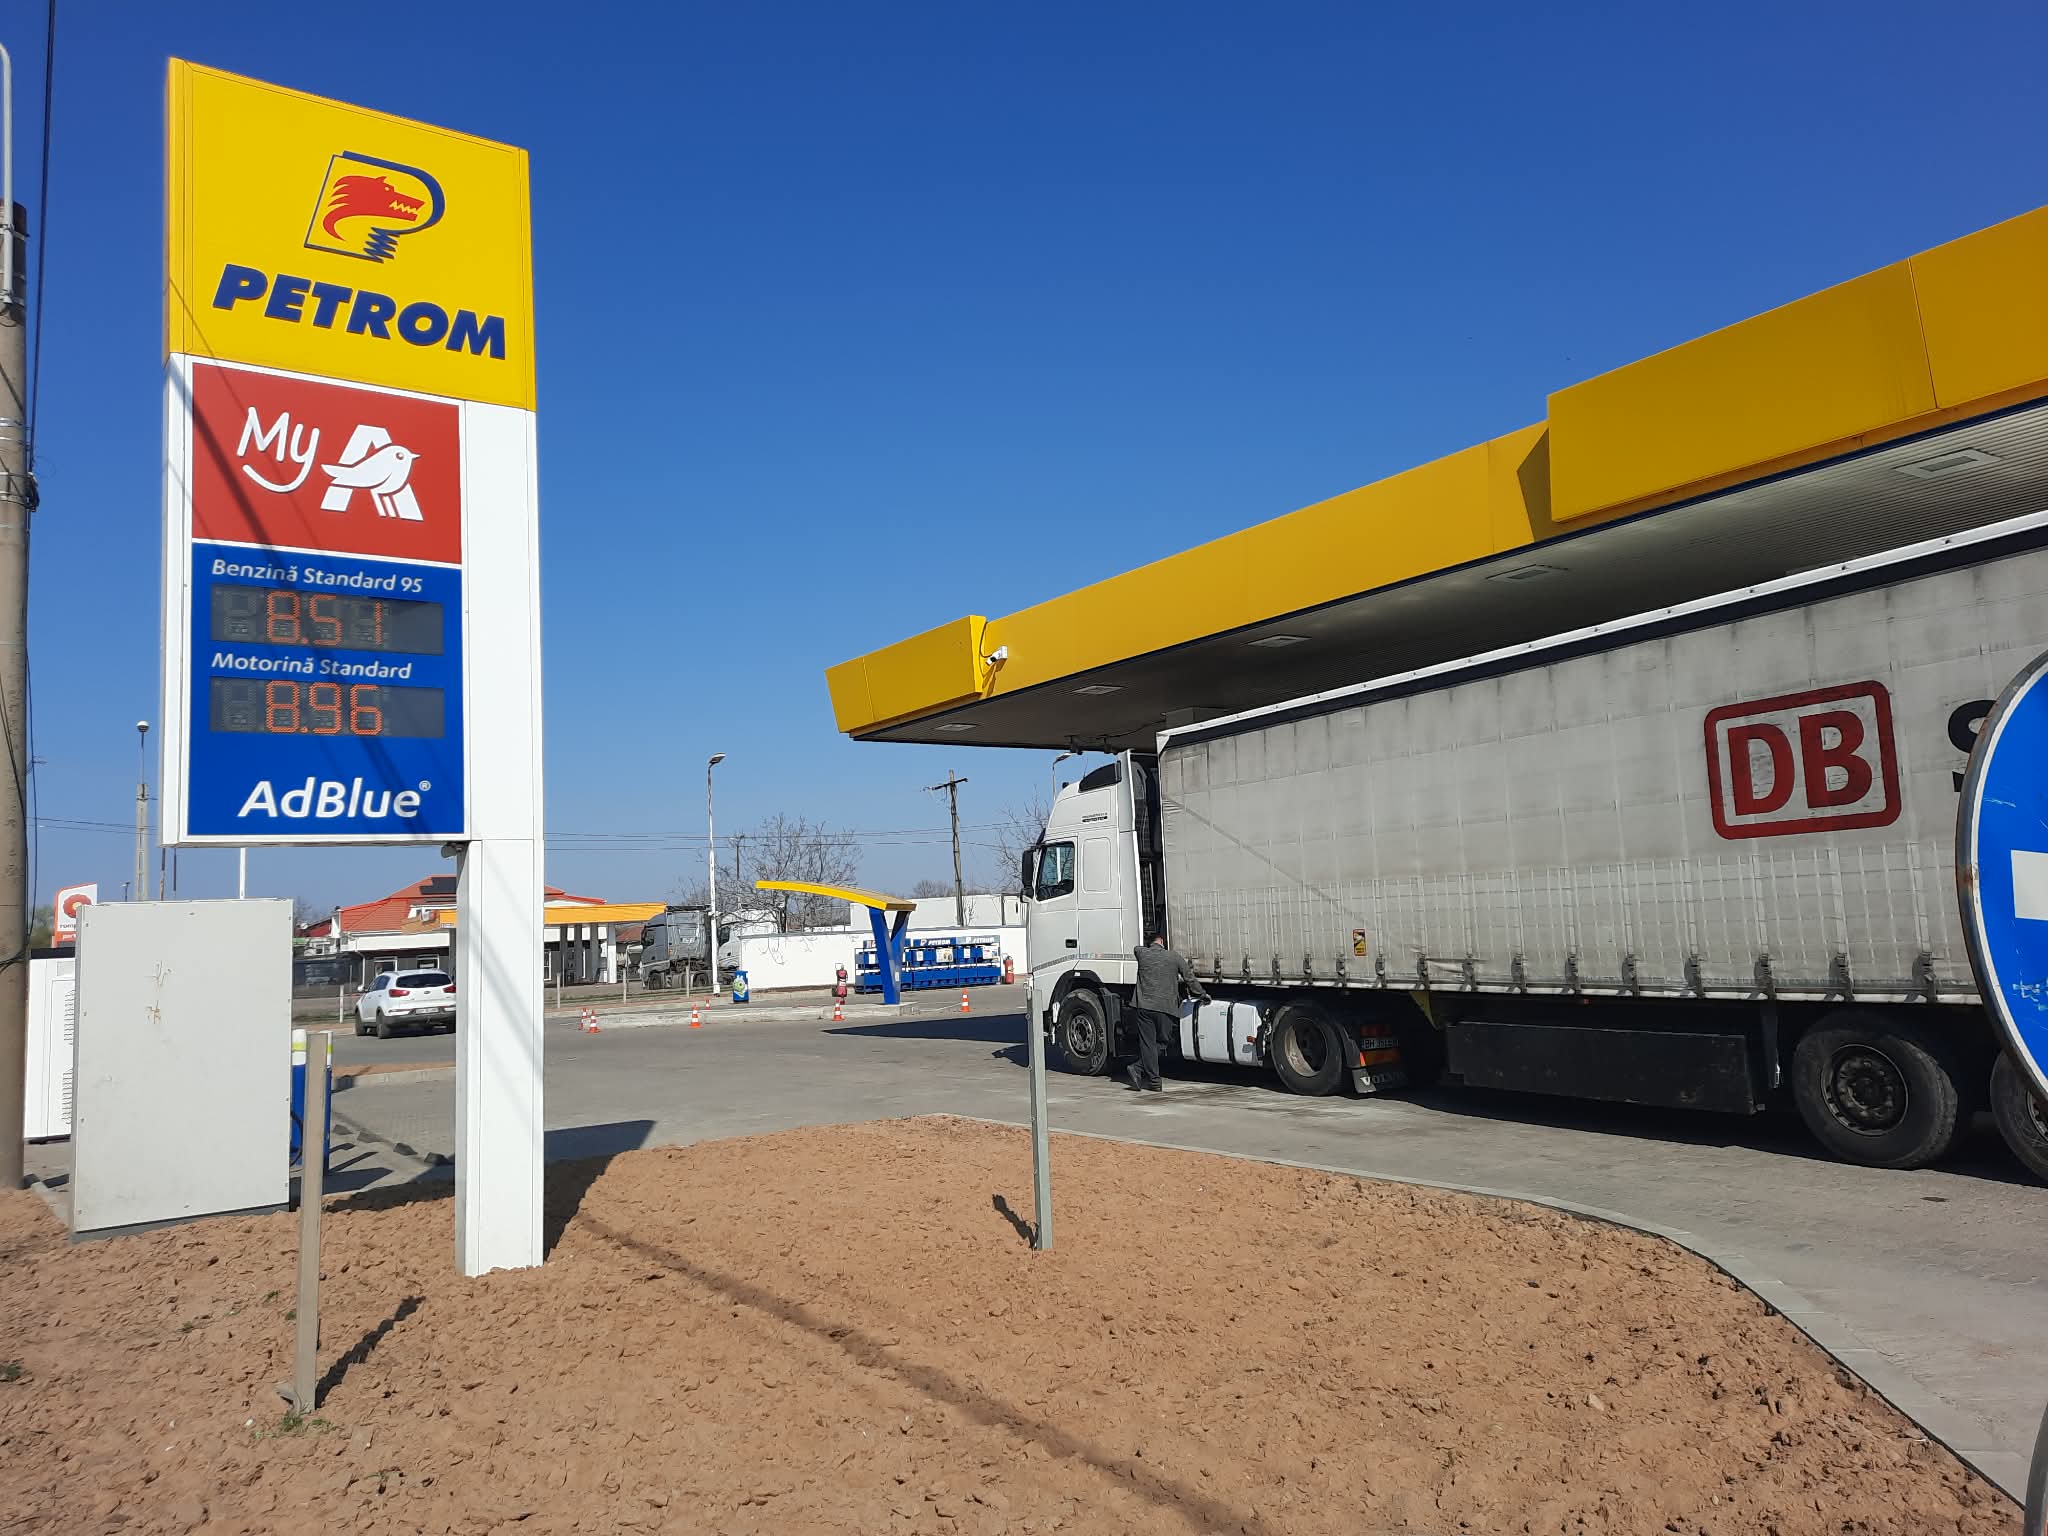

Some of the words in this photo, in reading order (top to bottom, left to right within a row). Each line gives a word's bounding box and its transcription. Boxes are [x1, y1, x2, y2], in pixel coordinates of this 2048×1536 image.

[212, 263, 506, 361] PETROM
[236, 406, 320, 493] My
[211, 558, 299, 582] Benzină
[303, 567, 397, 591] Standard
[400, 576, 423, 593] 95
[266, 591, 383, 646] 8.51
[211, 652, 314, 674] Motorină
[319, 658, 412, 679] Standard
[265, 680, 383, 736] 8.96
[1727, 710, 1873, 816] DB
